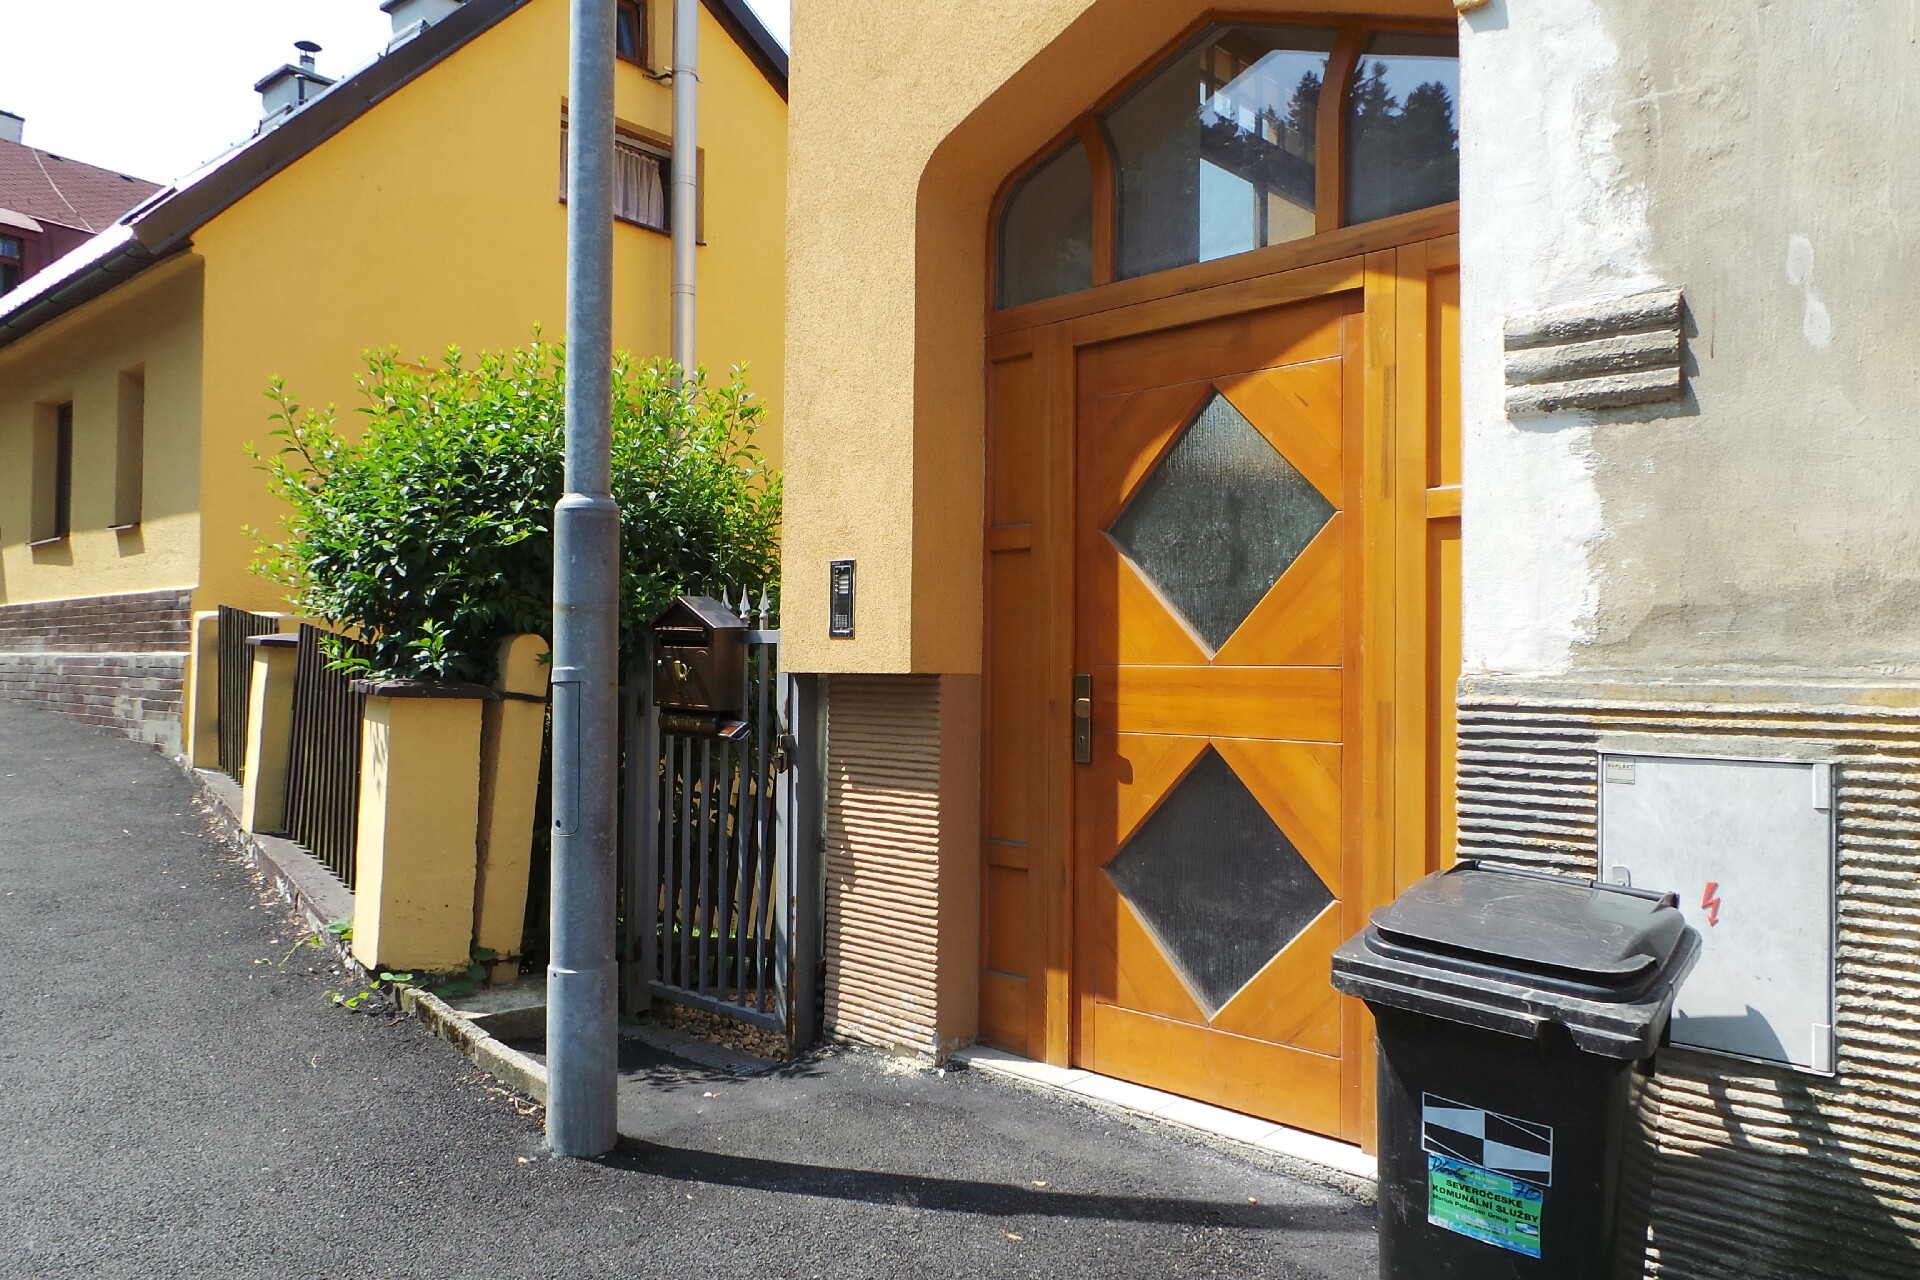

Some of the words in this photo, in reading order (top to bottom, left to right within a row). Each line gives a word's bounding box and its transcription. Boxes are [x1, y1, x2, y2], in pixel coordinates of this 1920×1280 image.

[1432, 1184, 1492, 1210] KOMUNÁLNÍ
[1495, 1204, 1539, 1222] SLUŽBY
[1432, 1194, 1454, 1206] Marius
[1454, 1199, 1486, 1216] Pedersen
[1487, 1211, 1509, 1224] Group
[1446, 1179, 1524, 1209] SEVEROČESKÉ
